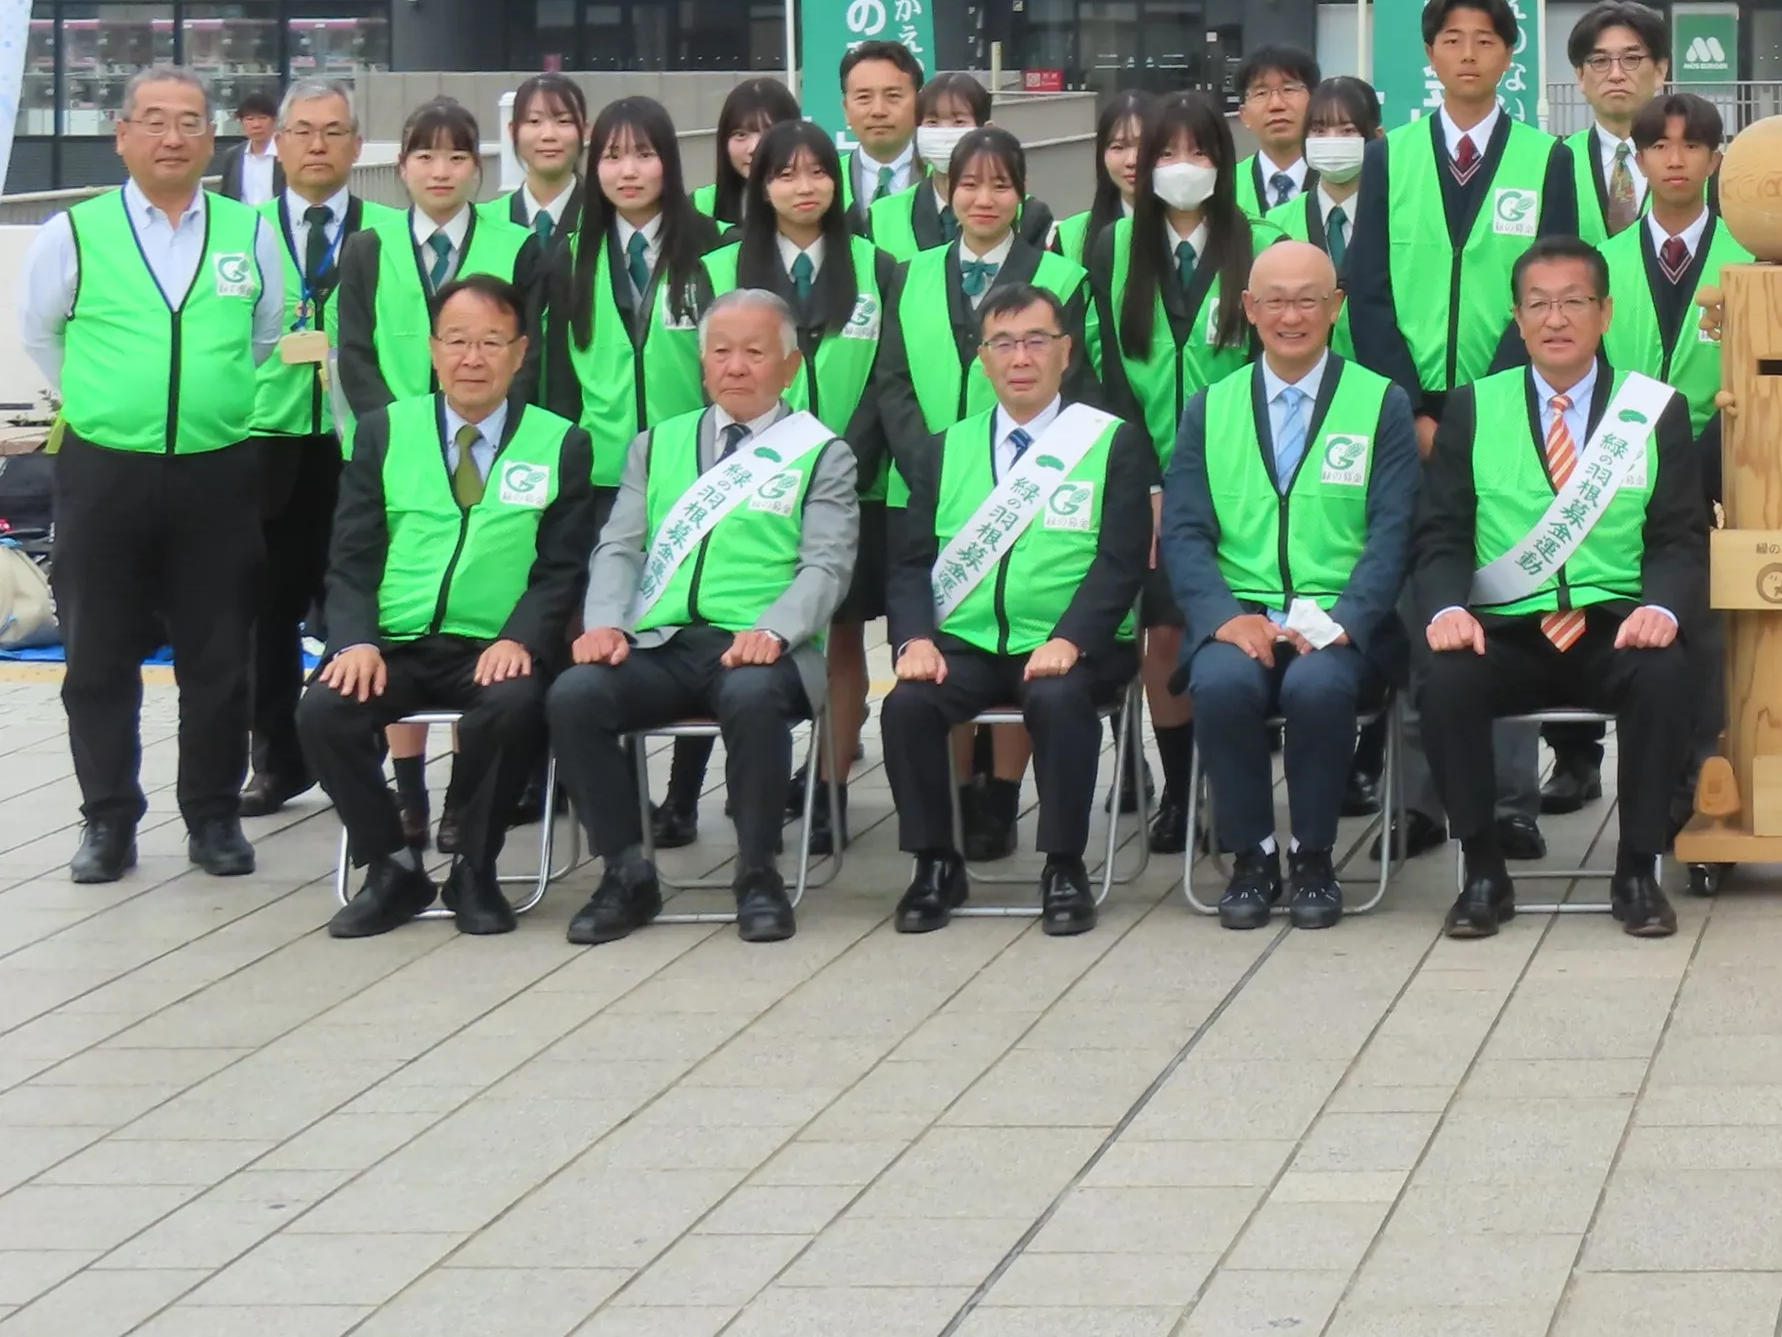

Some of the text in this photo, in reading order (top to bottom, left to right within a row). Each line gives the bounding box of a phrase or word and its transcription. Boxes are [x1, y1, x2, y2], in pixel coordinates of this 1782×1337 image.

[1514, 432, 1630, 576] 緑の羽根募金運動
